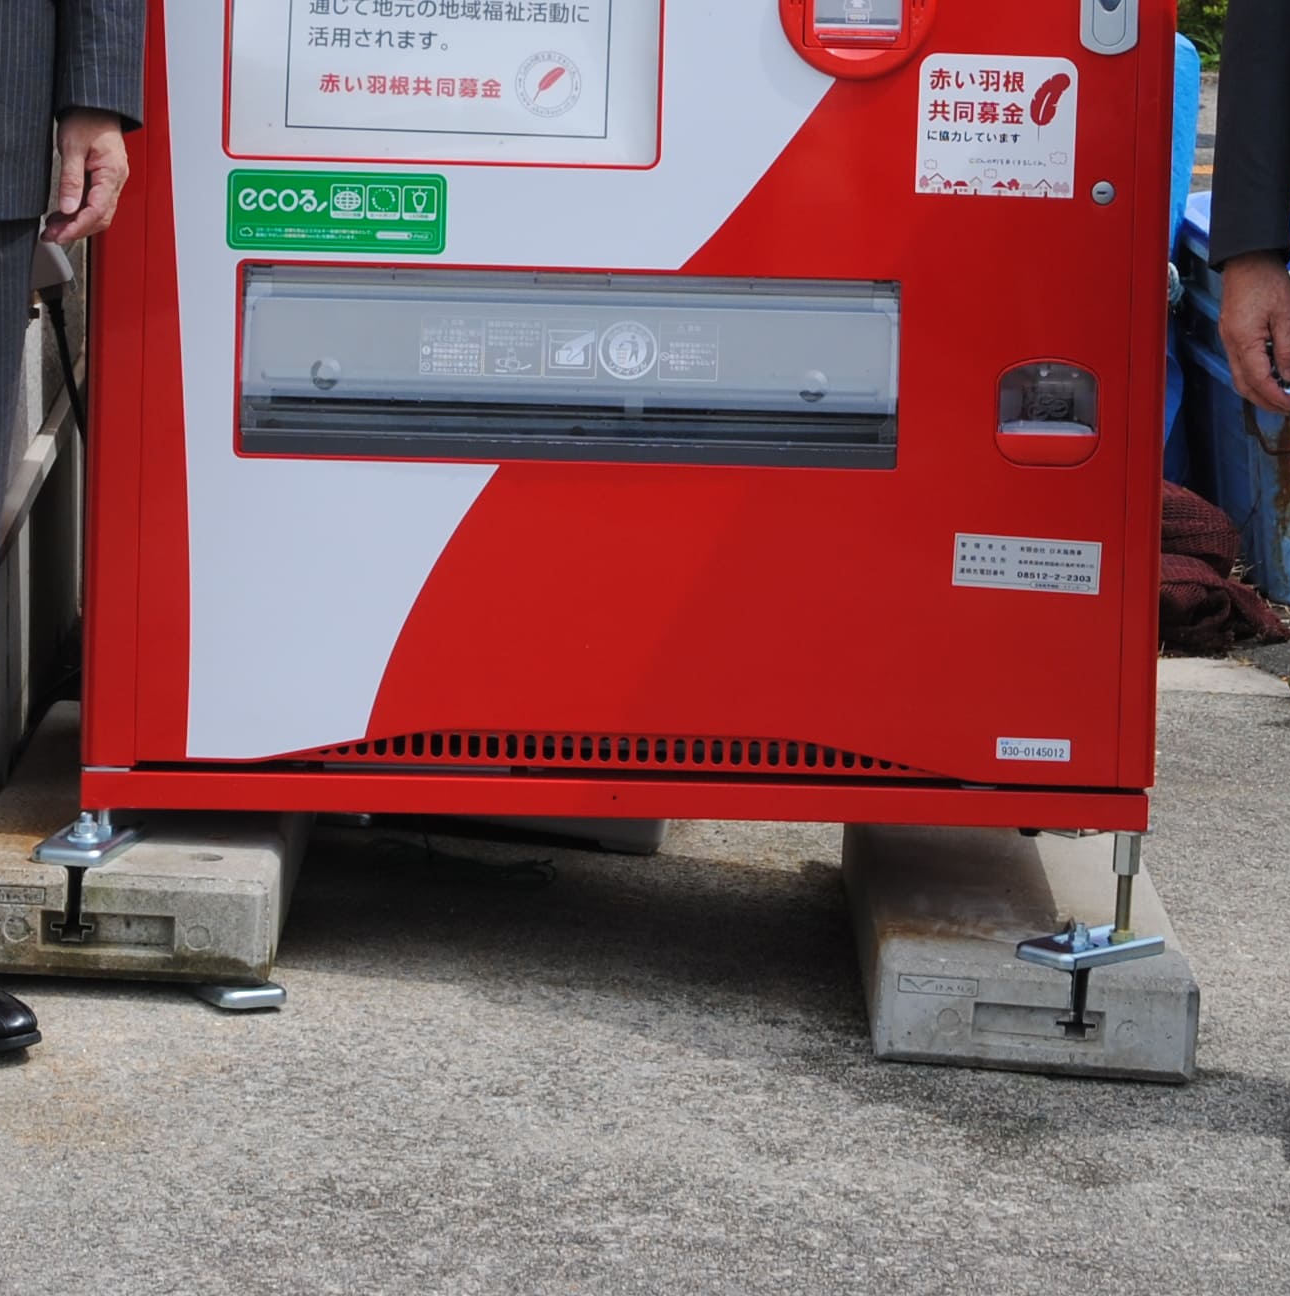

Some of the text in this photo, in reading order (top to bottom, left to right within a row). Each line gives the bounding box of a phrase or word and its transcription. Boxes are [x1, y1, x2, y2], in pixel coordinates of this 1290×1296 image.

[308, 26, 449, 52] 活用されます。
[319, 73, 502, 99] 赤い羽根共同募金
[929, 67, 1025, 93] 赤い羽根
[928, 99, 1024, 125] 共同募金
[927, 129, 1021, 144] に協力しています
[1016, 571, 1092, 583] 08512-2-2303
[1001, 746, 1065, 759] 930-0145012
